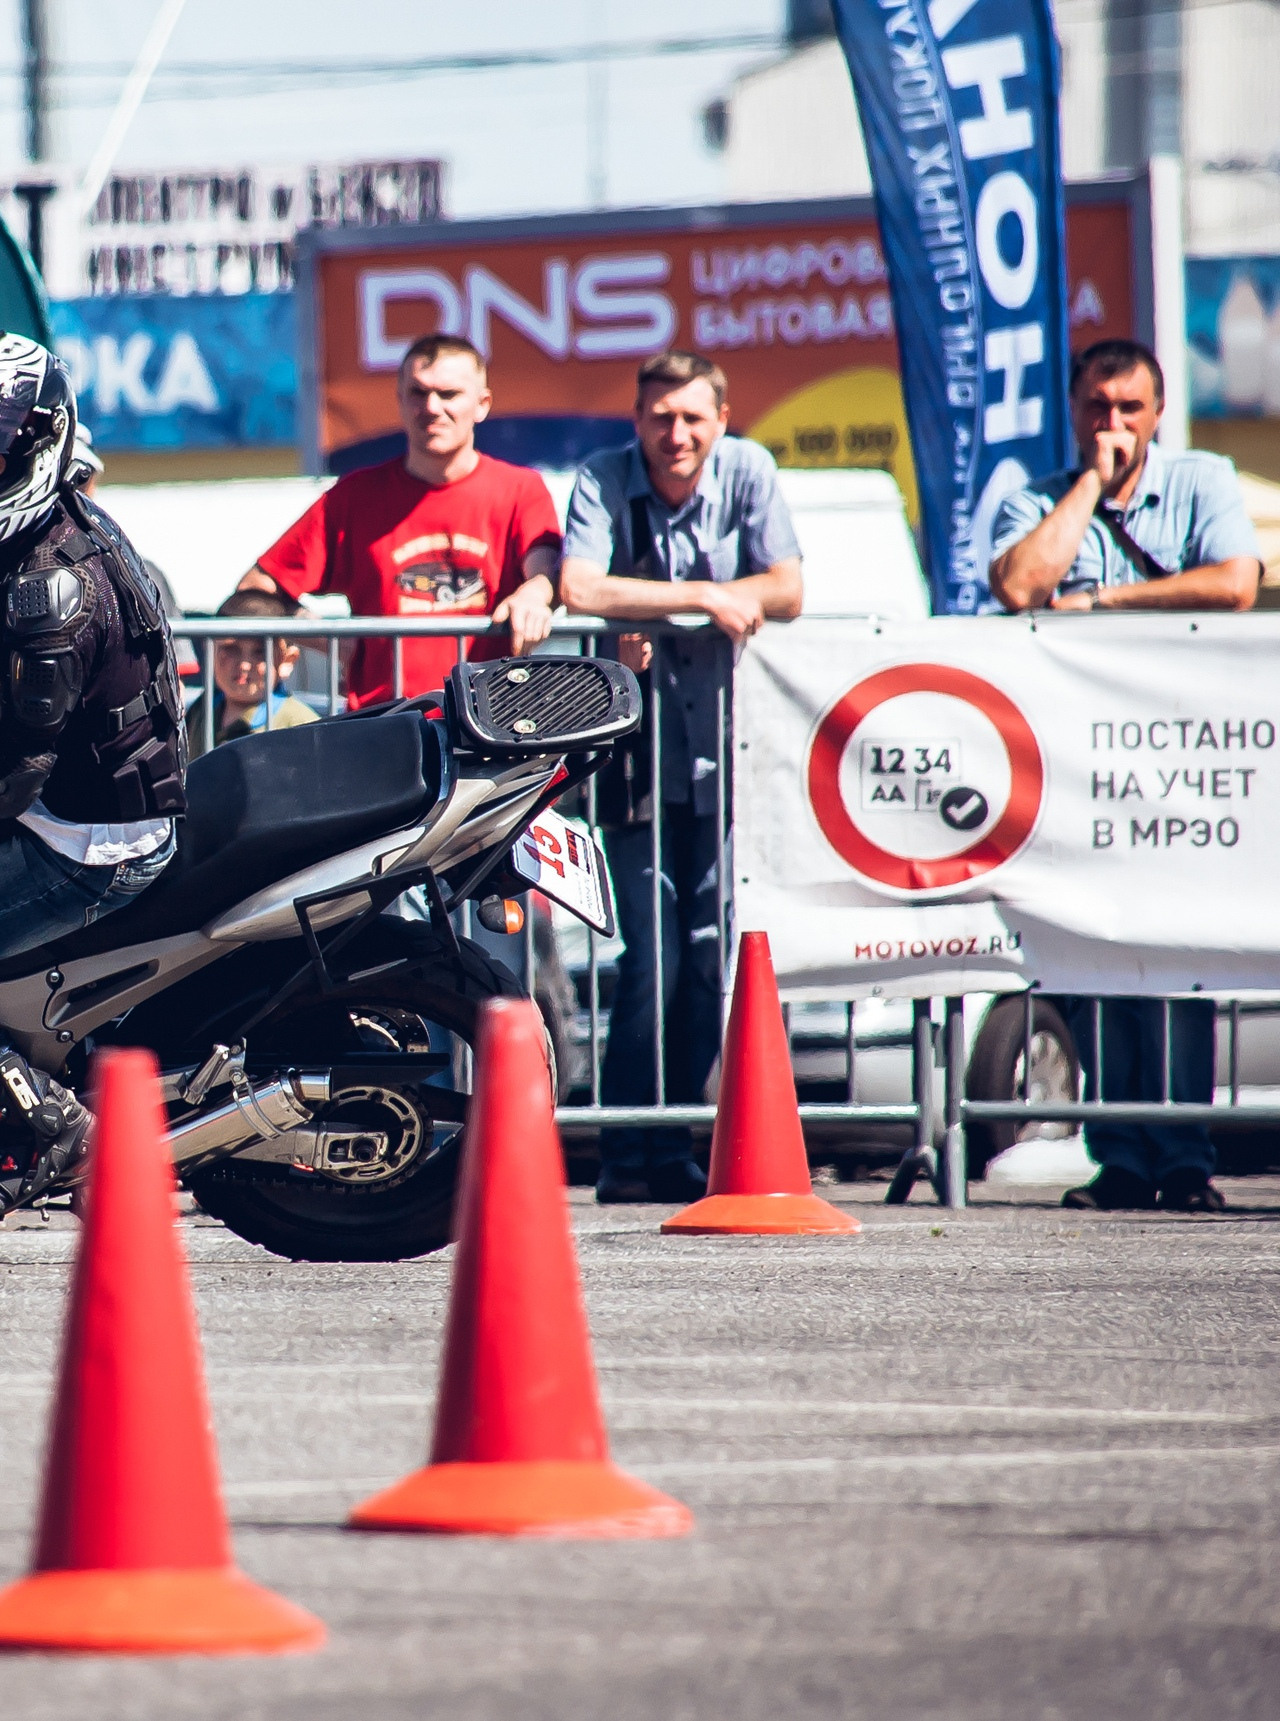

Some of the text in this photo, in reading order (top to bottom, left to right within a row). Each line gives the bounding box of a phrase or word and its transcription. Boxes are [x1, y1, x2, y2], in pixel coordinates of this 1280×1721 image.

[358, 252, 674, 372] DNS
[1092, 719, 1276, 750] ПОСТАНО
[1091, 768, 1257, 799] НА УЧЕТ
[1092, 817, 1240, 848] В МРЭО
